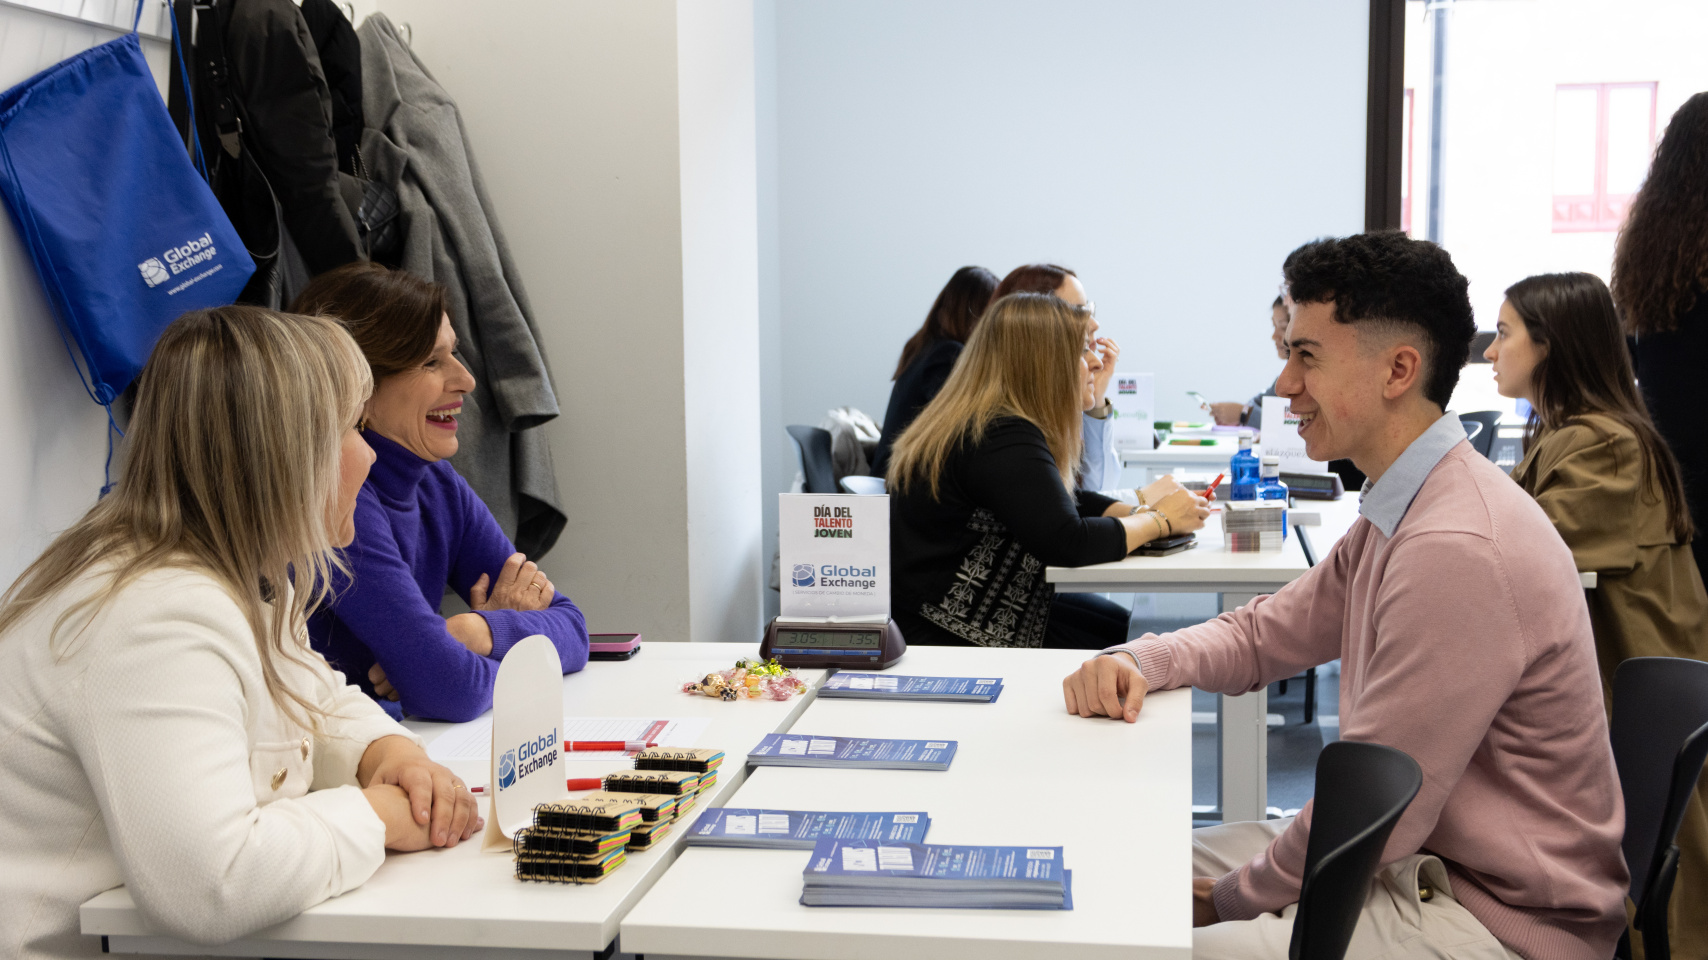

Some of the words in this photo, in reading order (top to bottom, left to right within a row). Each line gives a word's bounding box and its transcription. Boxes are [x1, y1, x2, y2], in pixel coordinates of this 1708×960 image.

[163, 232, 213, 264] Global
[169, 246, 217, 275] Exchange
[813, 503, 832, 518] DÍA
[834, 506, 853, 518] DEL
[814, 518, 853, 529] TALENTO
[814, 528, 853, 538] JOVEN
[820, 564, 876, 577] Global
[820, 577, 876, 590] Exchange
[518, 727, 557, 762] Global
[518, 749, 558, 779] Exchange
